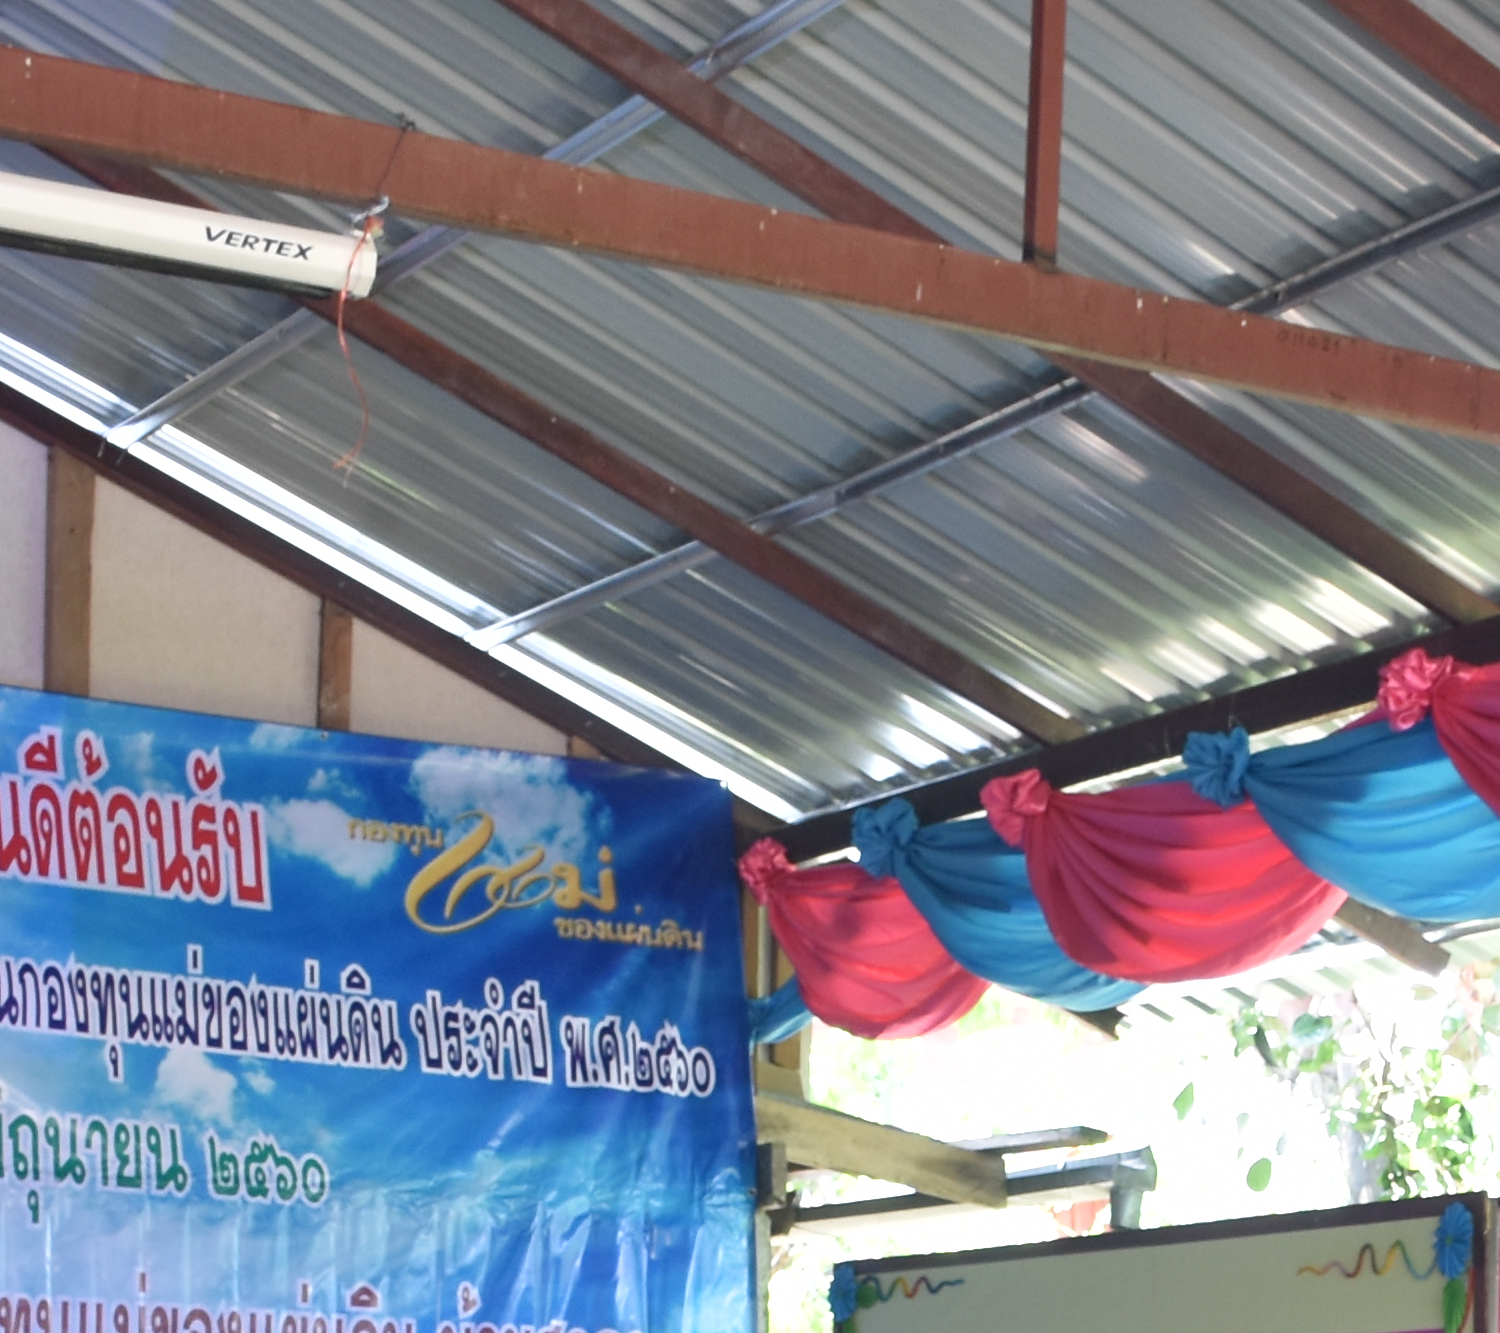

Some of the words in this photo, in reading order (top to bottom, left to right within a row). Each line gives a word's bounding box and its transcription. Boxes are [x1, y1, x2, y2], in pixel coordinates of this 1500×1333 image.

[205, 226, 314, 261] VERTEX
[348, 816, 443, 856] กองทุน
[554, 905, 703, 950] ของแผ่นดิน
[412, 979, 551, 1082] ประจำปี
[562, 1019, 714, 1094] พ.ศ.๒๕๖๐
[207, 1134, 327, 1202] ๒๕๖๐
